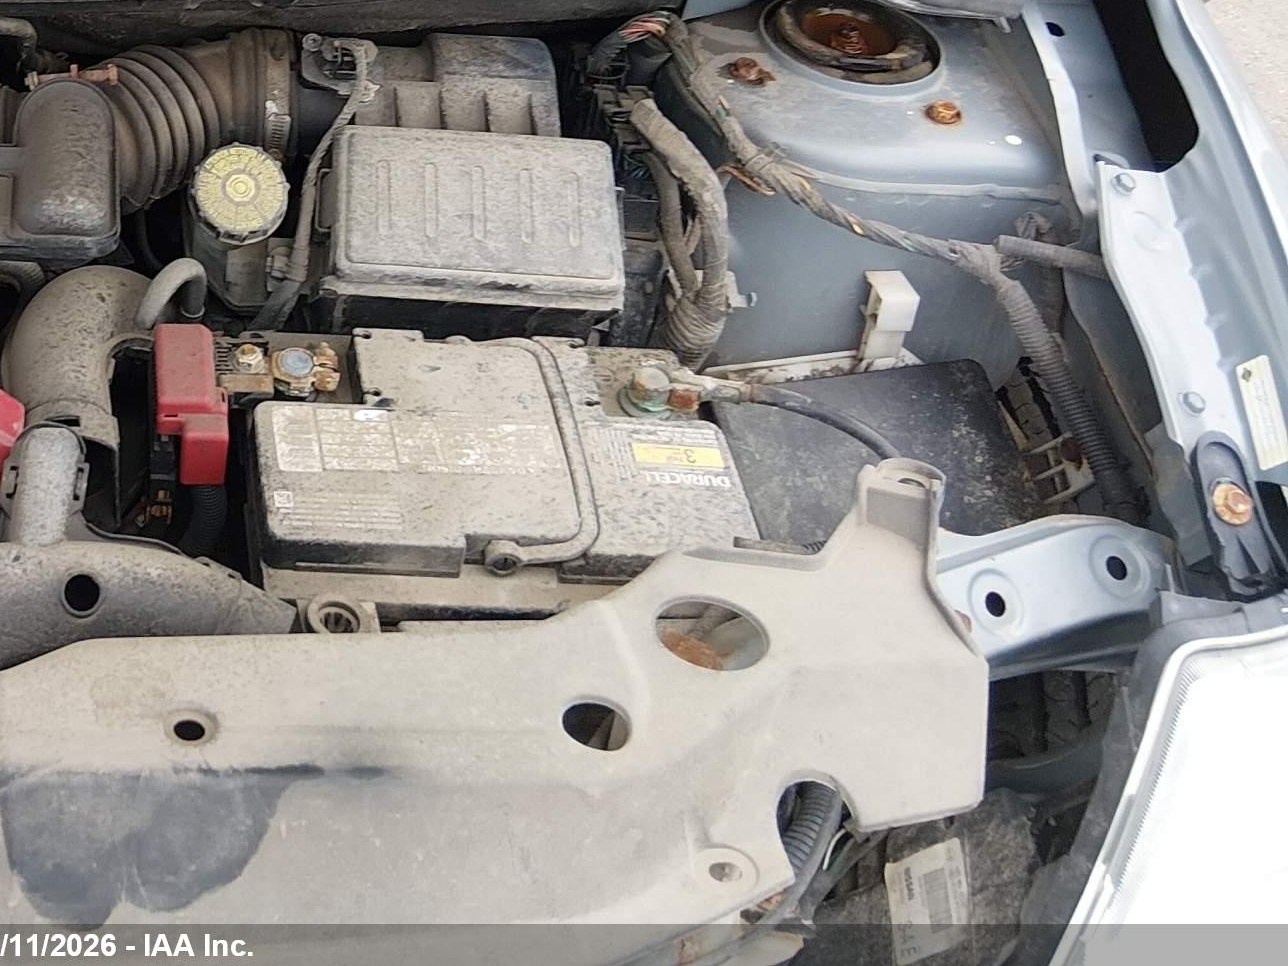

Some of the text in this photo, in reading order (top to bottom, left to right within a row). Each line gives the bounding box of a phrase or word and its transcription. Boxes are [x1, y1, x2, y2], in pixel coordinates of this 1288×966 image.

[683, 448, 697, 464] 3
[645, 470, 732, 488] DURACELL
[903, 866, 915, 902] NISSAN
